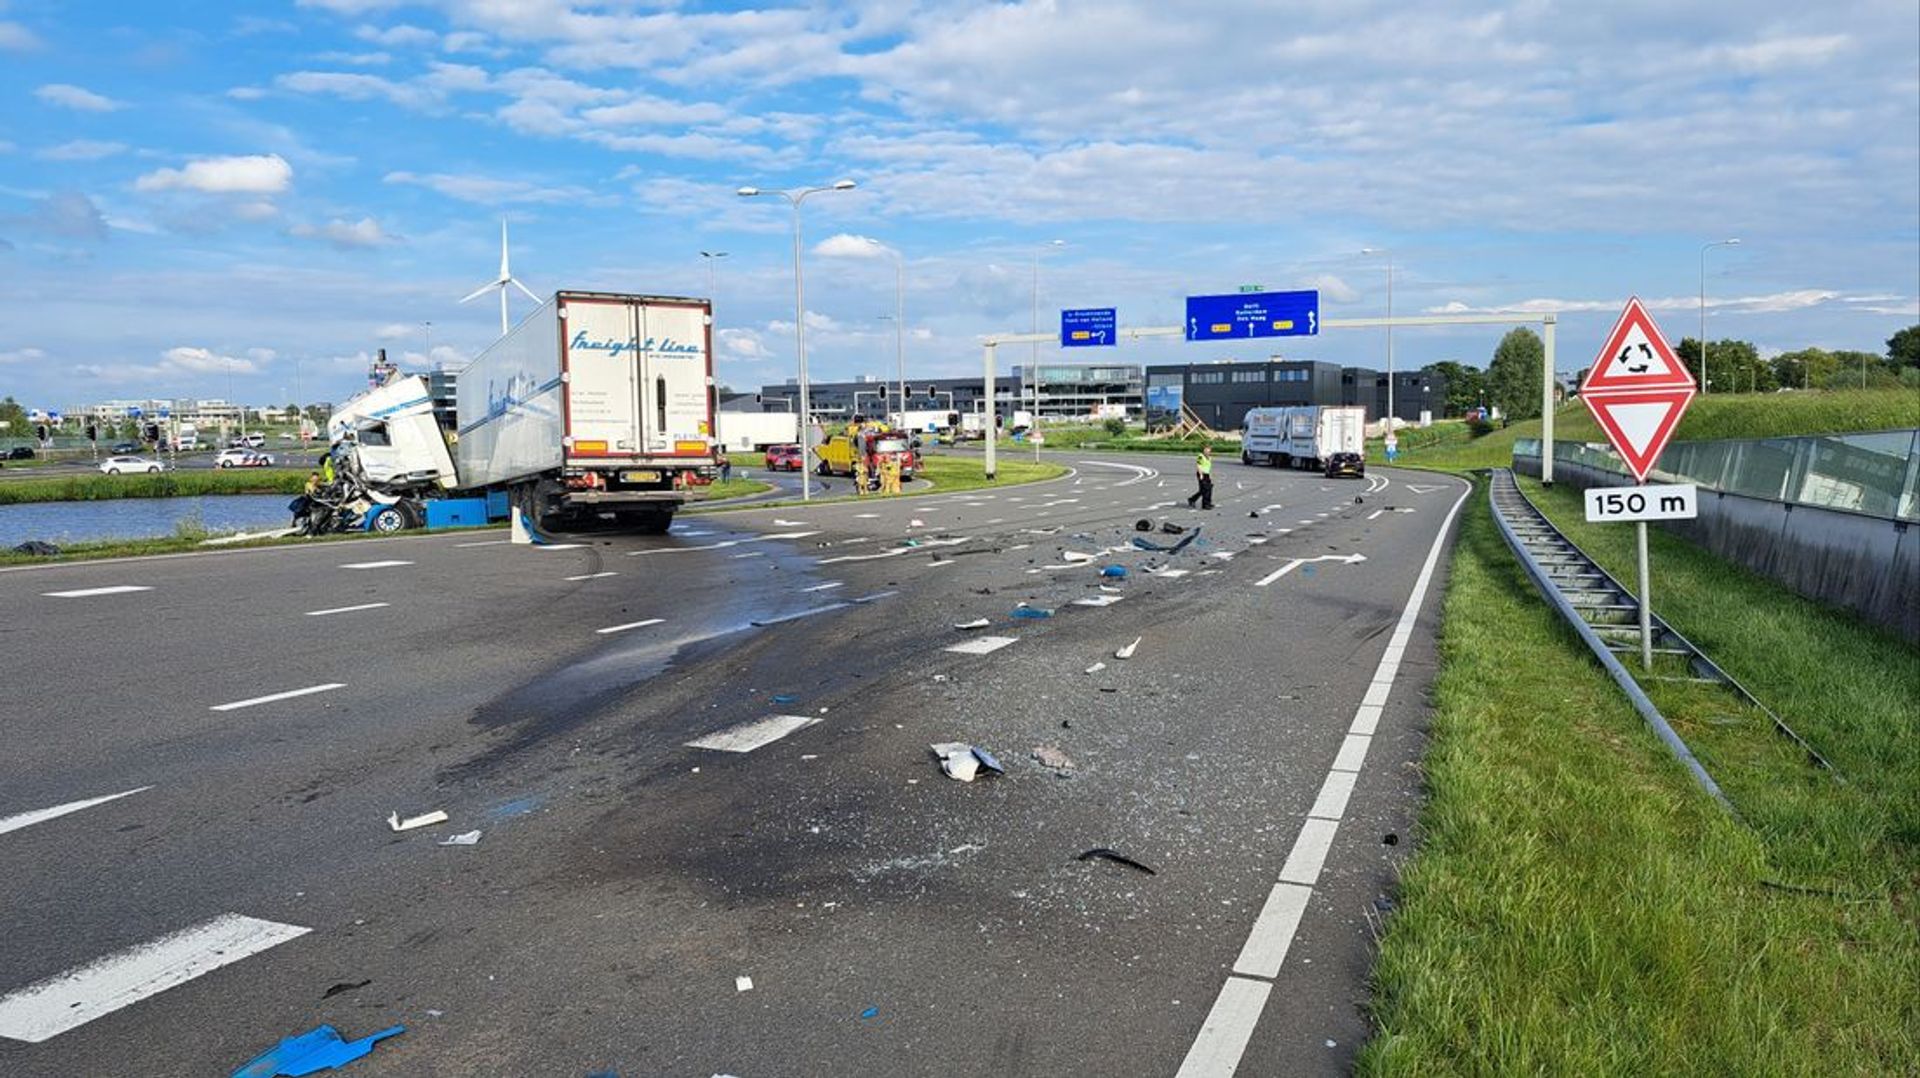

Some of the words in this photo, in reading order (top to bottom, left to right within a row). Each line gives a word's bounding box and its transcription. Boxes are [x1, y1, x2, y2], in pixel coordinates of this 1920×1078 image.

[658, 339, 699, 353] line
[1595, 493, 1646, 515] 150
[1660, 496, 1685, 512] m
